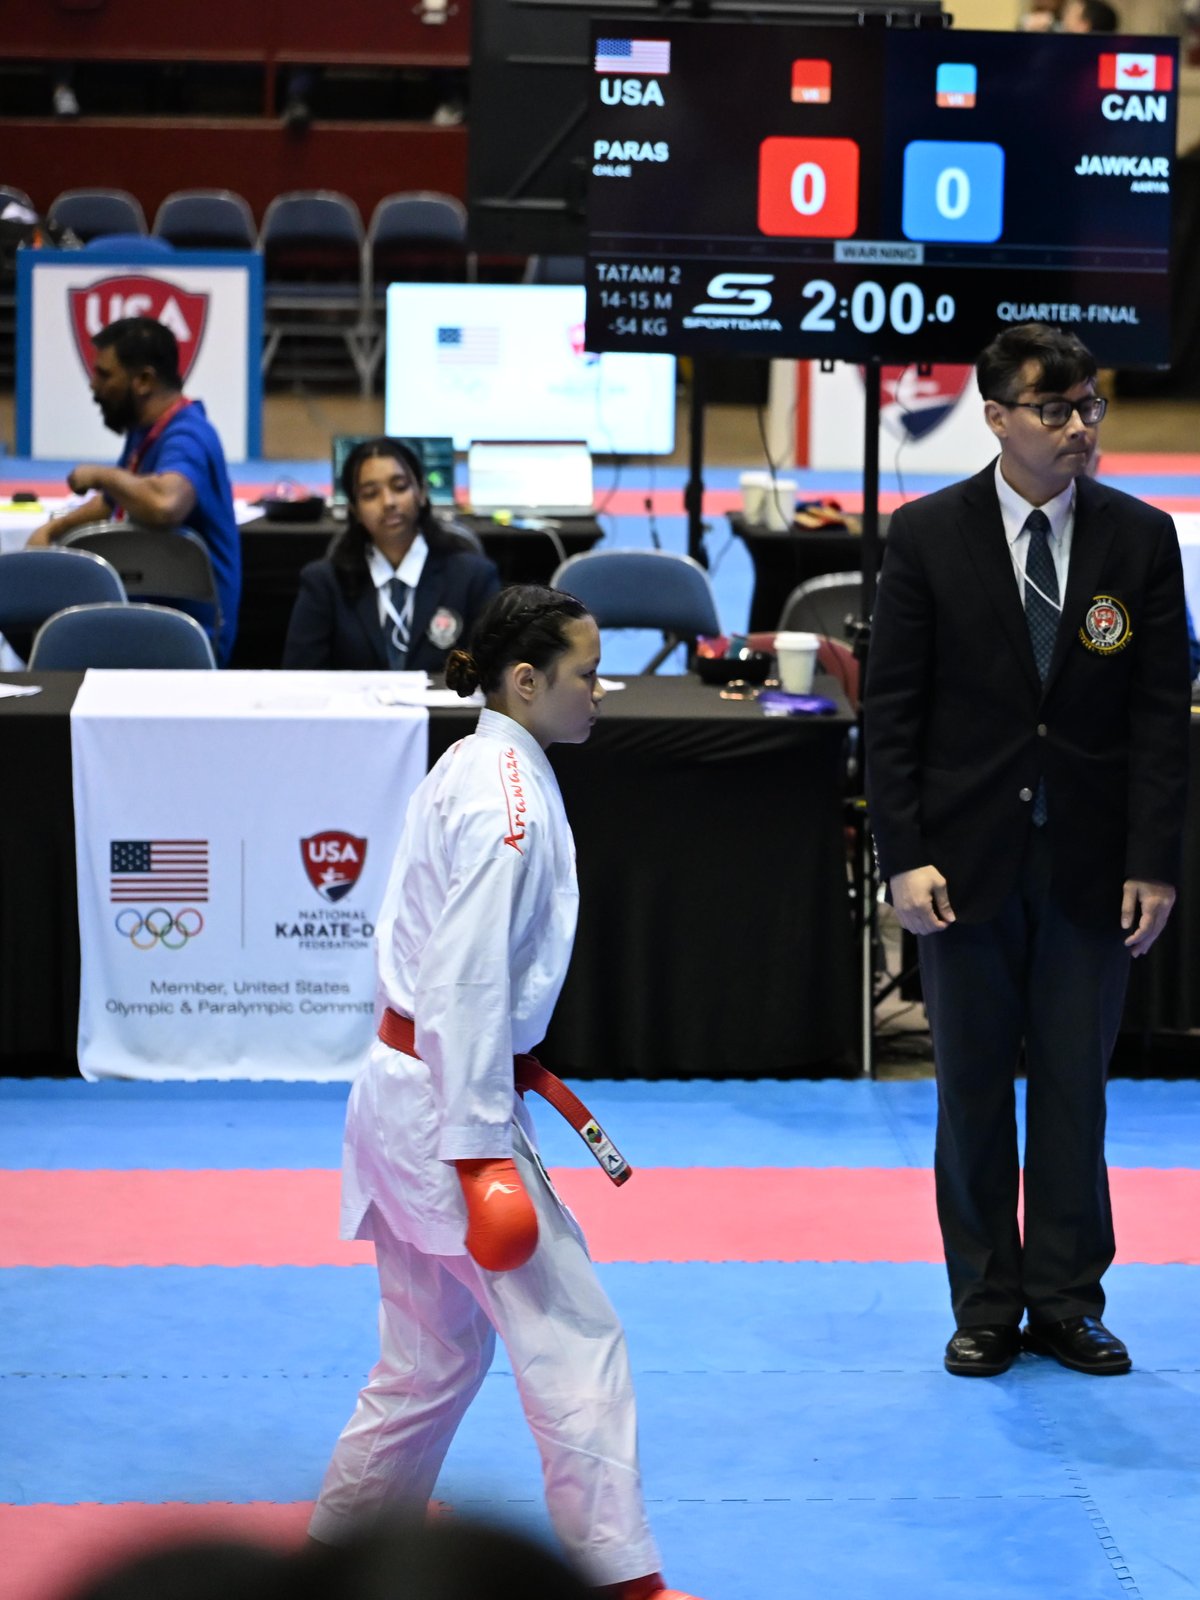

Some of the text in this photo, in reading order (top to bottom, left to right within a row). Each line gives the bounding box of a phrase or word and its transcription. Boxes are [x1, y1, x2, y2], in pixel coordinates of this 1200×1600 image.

[600, 77, 665, 107] USA
[1101, 94, 1168, 122] CAN
[593, 140, 670, 162] PARAS
[1074, 155, 1169, 178] JAWKAR
[791, 162, 826, 216] 0
[935, 166, 970, 220] 0
[842, 246, 917, 261] WARNING
[596, 264, 682, 285] TATAMI 2
[600, 291, 672, 310] 14-15 M
[800, 279, 955, 335] 2:00.0
[997, 301, 1141, 325] QUARTER-FINAL
[608, 316, 668, 336] -54 KG
[682, 316, 782, 332] SPORTDATA
[500, 747, 527, 857] Arawaza
[308, 840, 359, 863] USA
[298, 910, 367, 921] NATIONAL
[275, 922, 375, 939] KARATE-D
[298, 940, 369, 950] FEDERATION
[150, 980, 351, 997] Member, United States
[105, 998, 375, 1018] Olympic & Paralympic Committ
